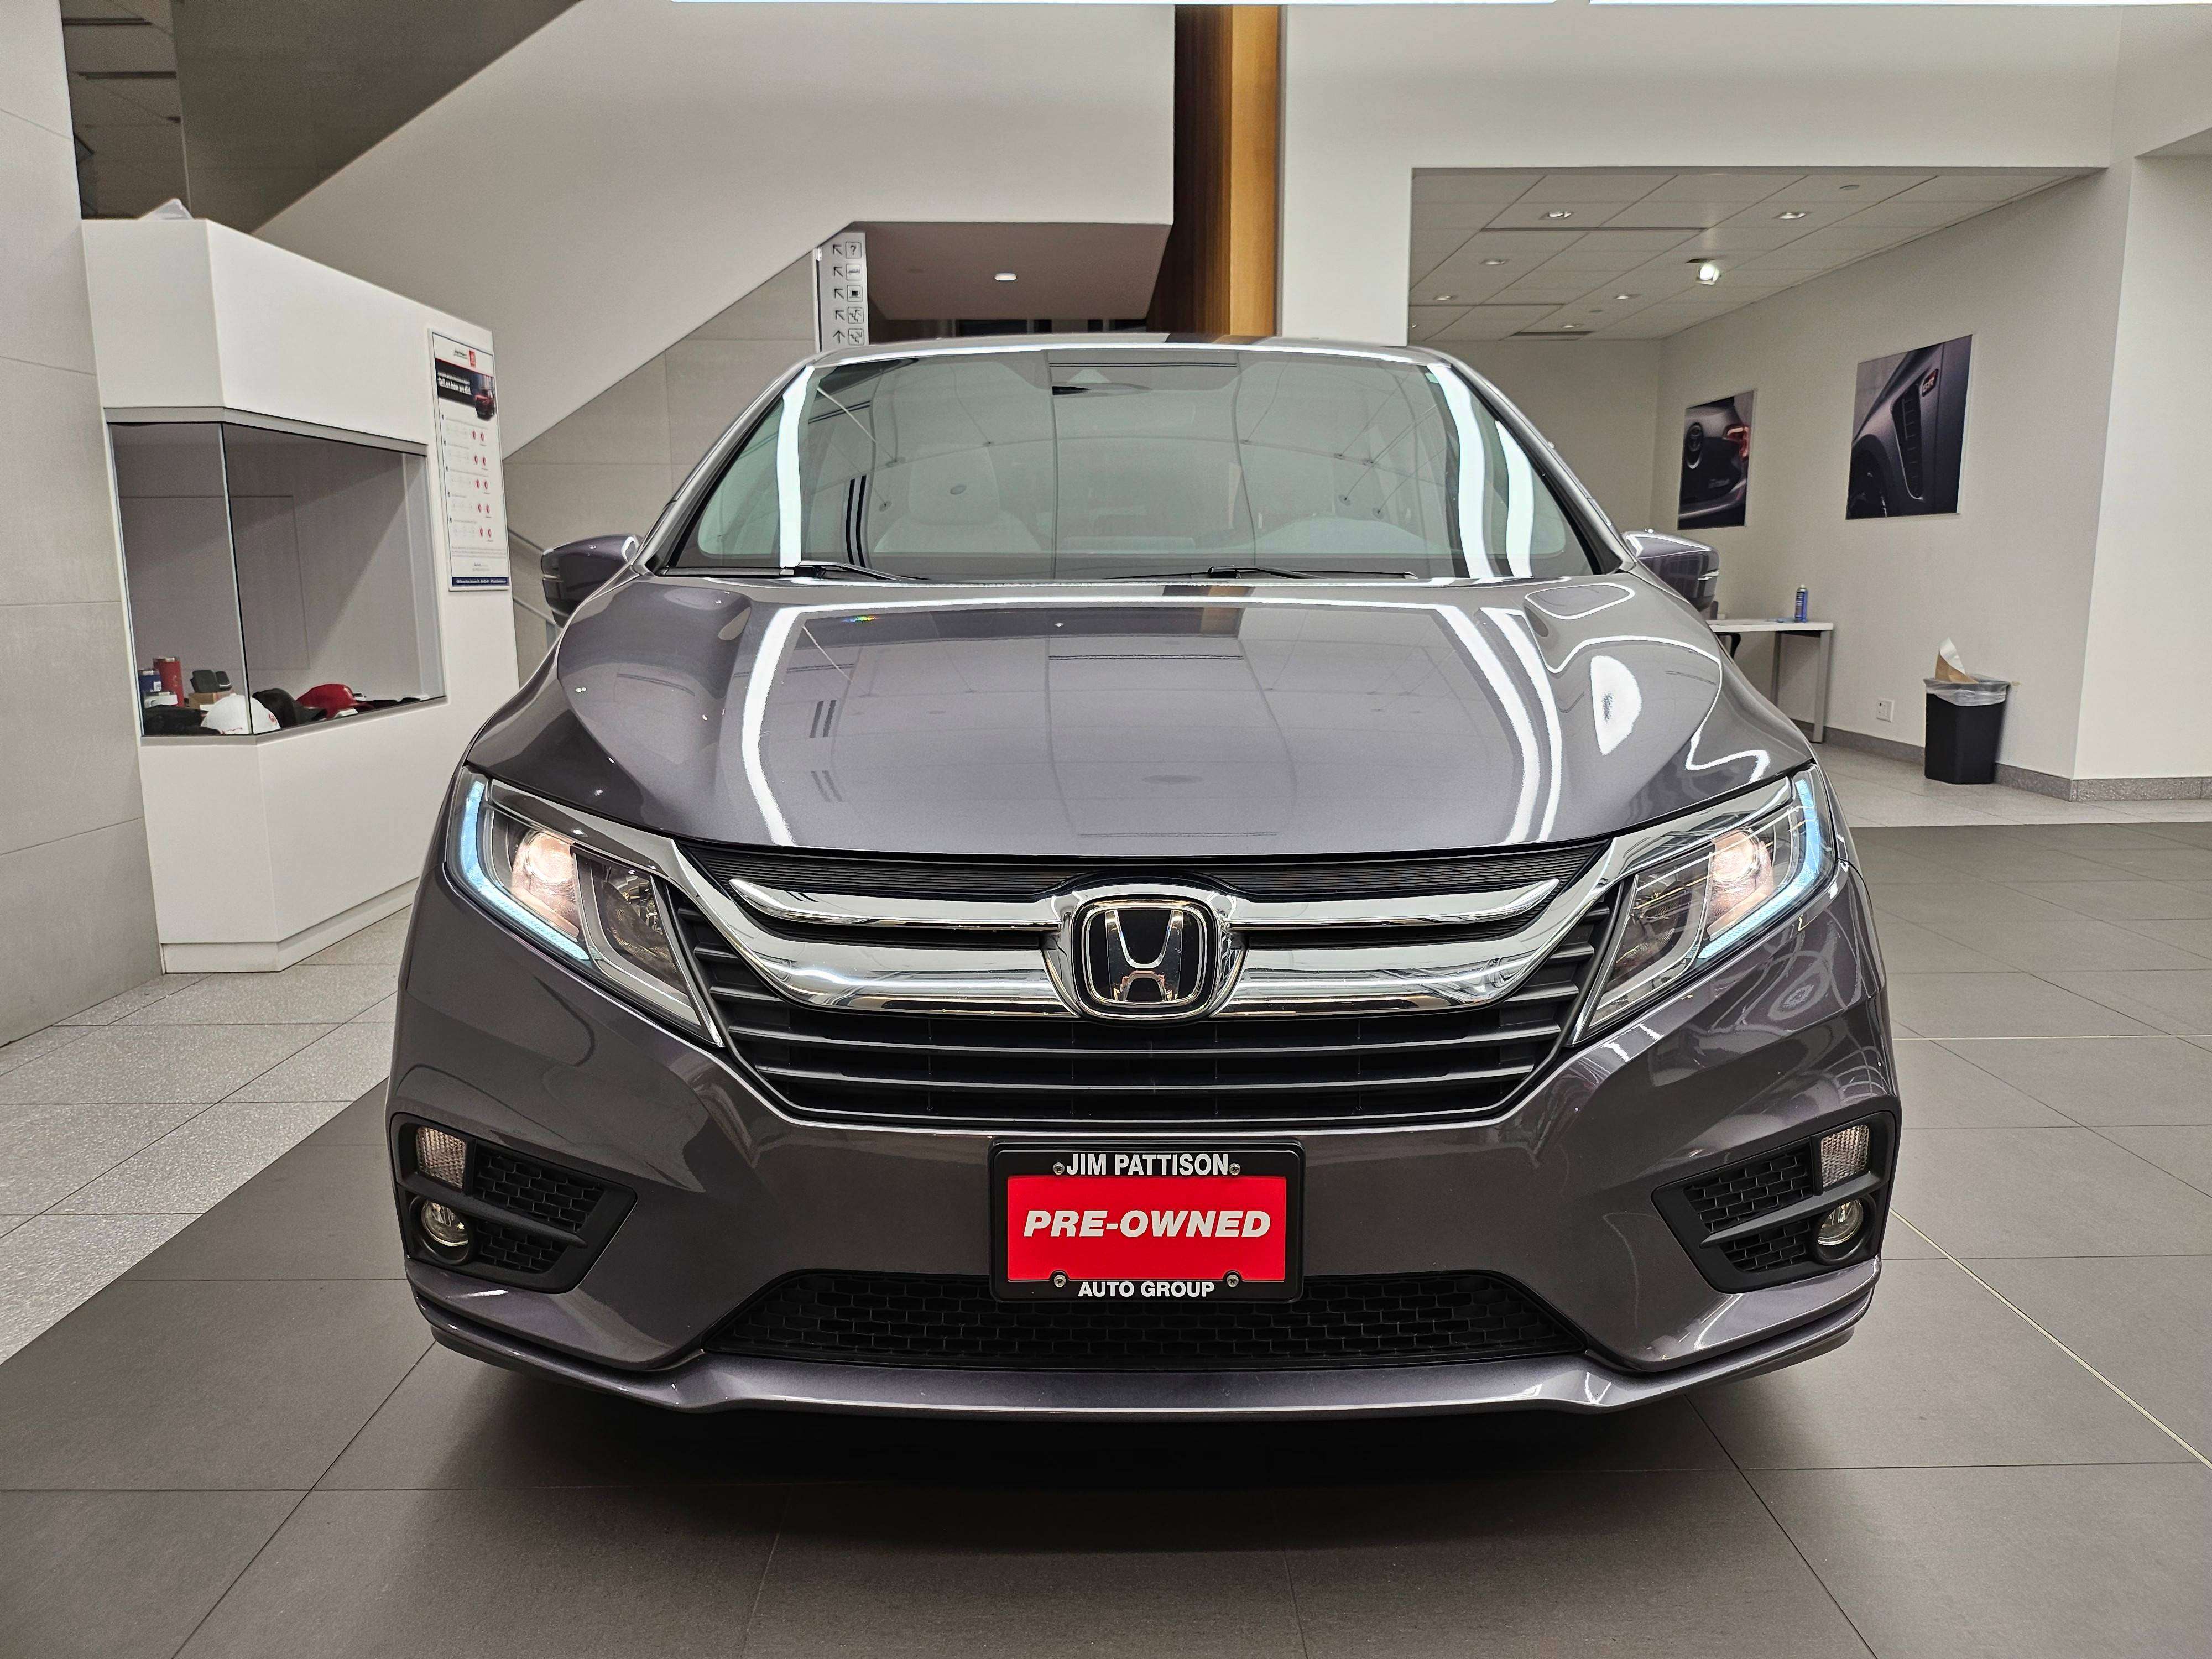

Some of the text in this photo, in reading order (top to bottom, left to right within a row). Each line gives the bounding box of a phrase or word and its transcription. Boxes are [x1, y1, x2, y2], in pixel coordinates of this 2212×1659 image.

[1066, 1153, 1228, 1176] JIM PATTISON
[1023, 1209, 1271, 1237] PRE-OWNED
[1078, 1281, 1215, 1297] AUTO GROUP
